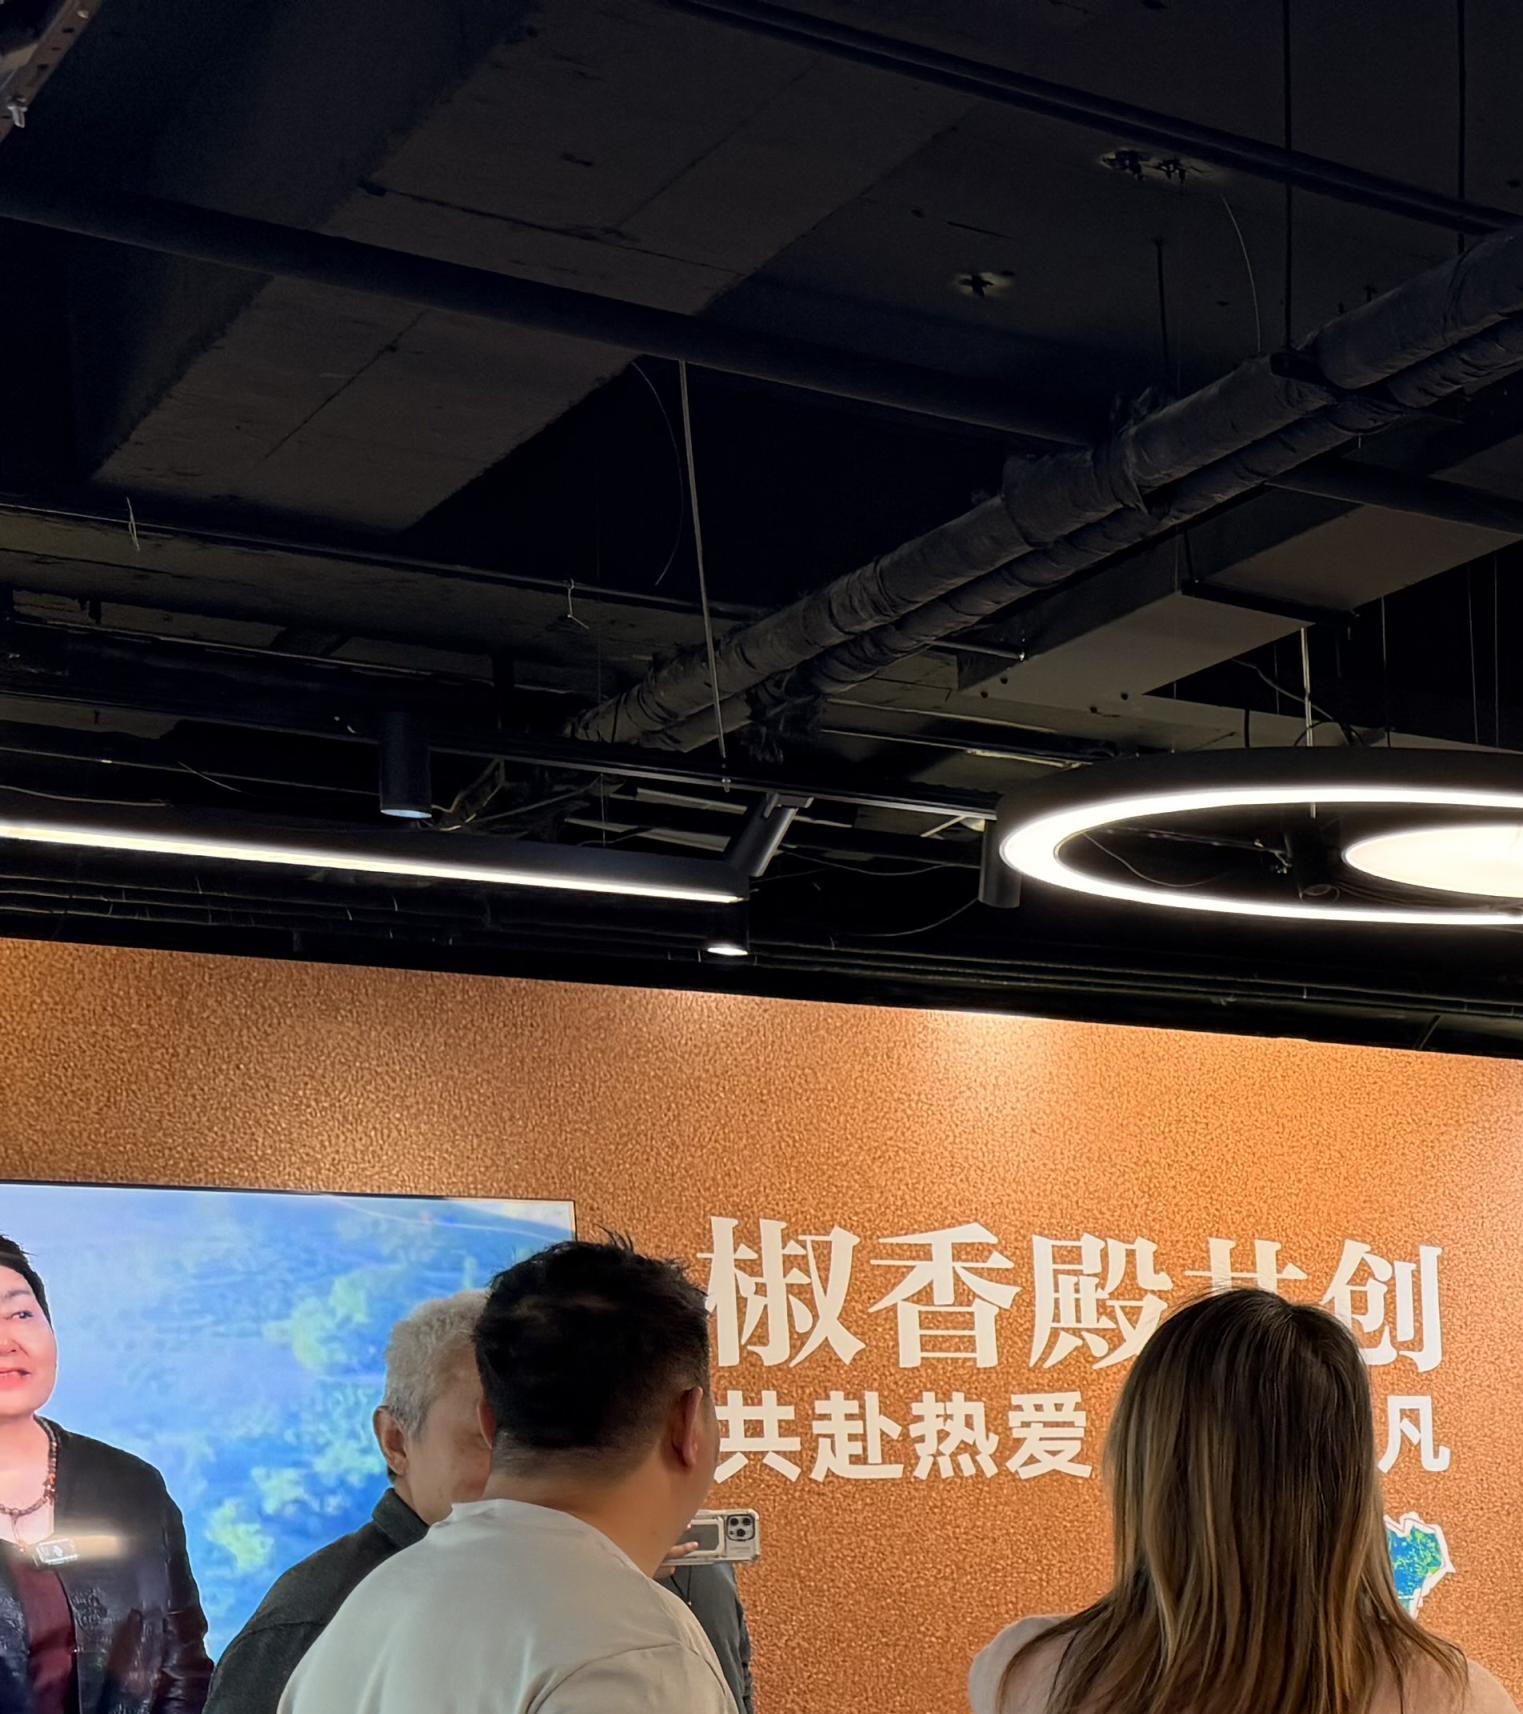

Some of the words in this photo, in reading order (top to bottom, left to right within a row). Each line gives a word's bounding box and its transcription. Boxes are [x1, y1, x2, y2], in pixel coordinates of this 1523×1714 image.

[713, 1390, 1093, 1484] 共赴热爱
[1377, 1395, 1450, 1473] 凡
